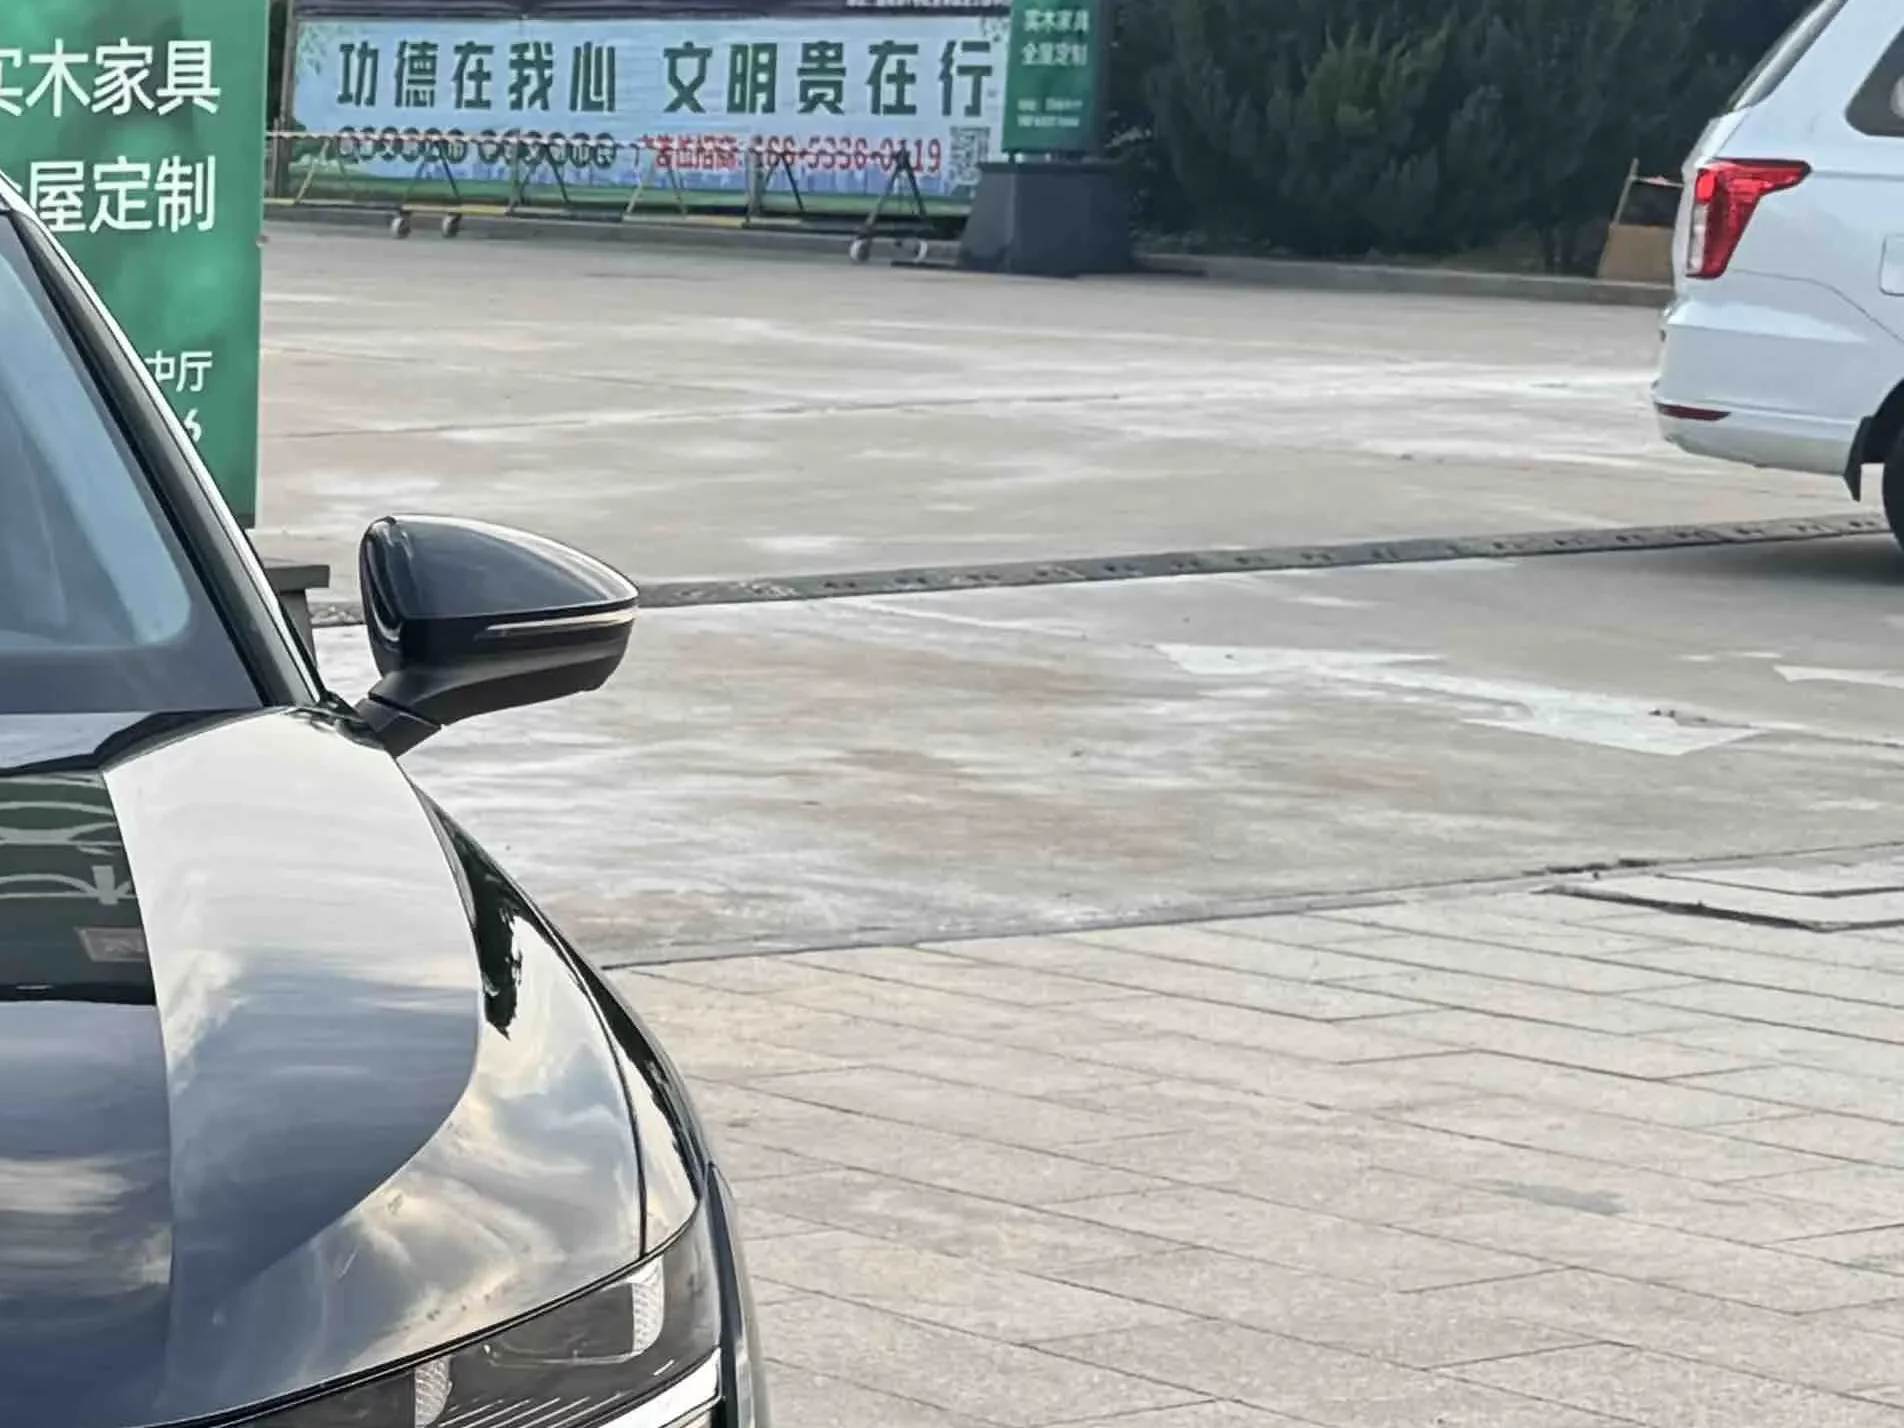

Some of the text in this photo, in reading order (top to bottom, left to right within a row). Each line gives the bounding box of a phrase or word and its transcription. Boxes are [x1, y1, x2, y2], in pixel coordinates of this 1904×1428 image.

[336, 39, 994, 118] 功德在我心 文明贵在行
